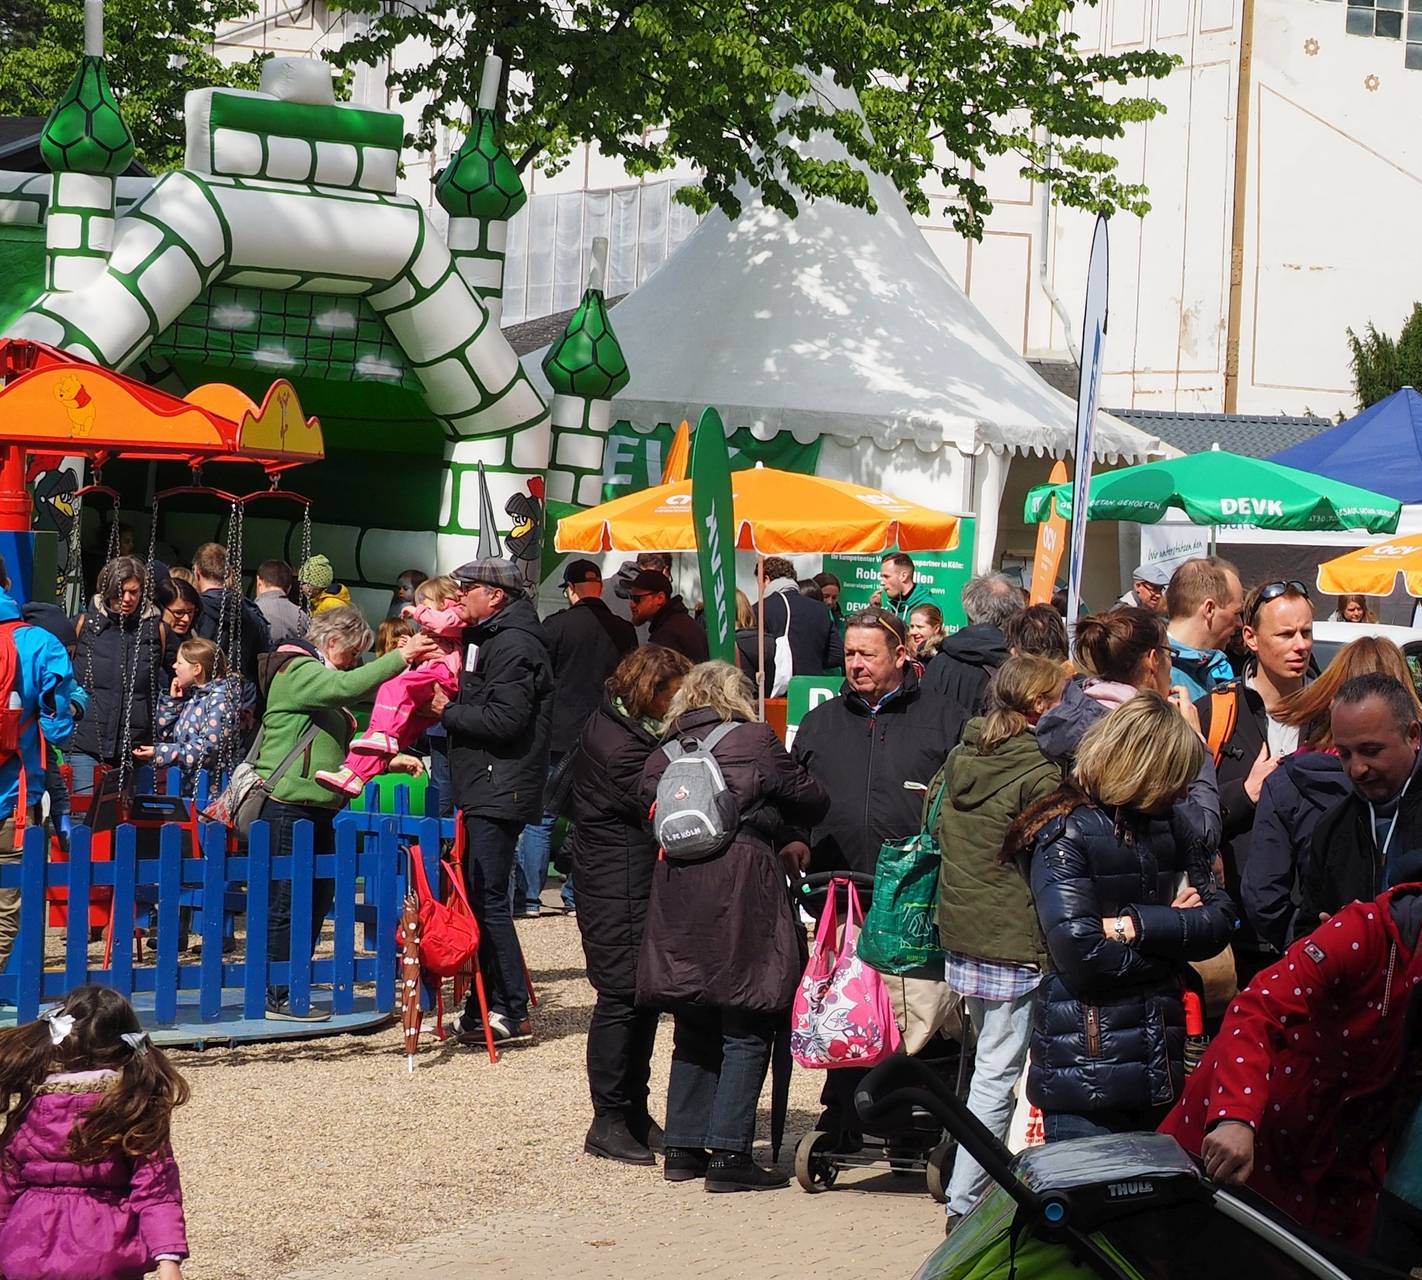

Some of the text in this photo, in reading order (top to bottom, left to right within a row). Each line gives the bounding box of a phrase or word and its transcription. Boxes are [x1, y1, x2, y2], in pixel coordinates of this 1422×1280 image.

[1220, 497, 1284, 516] DEVK
[705, 497, 728, 645] DEVK
[1107, 1181, 1153, 1197] THULE
